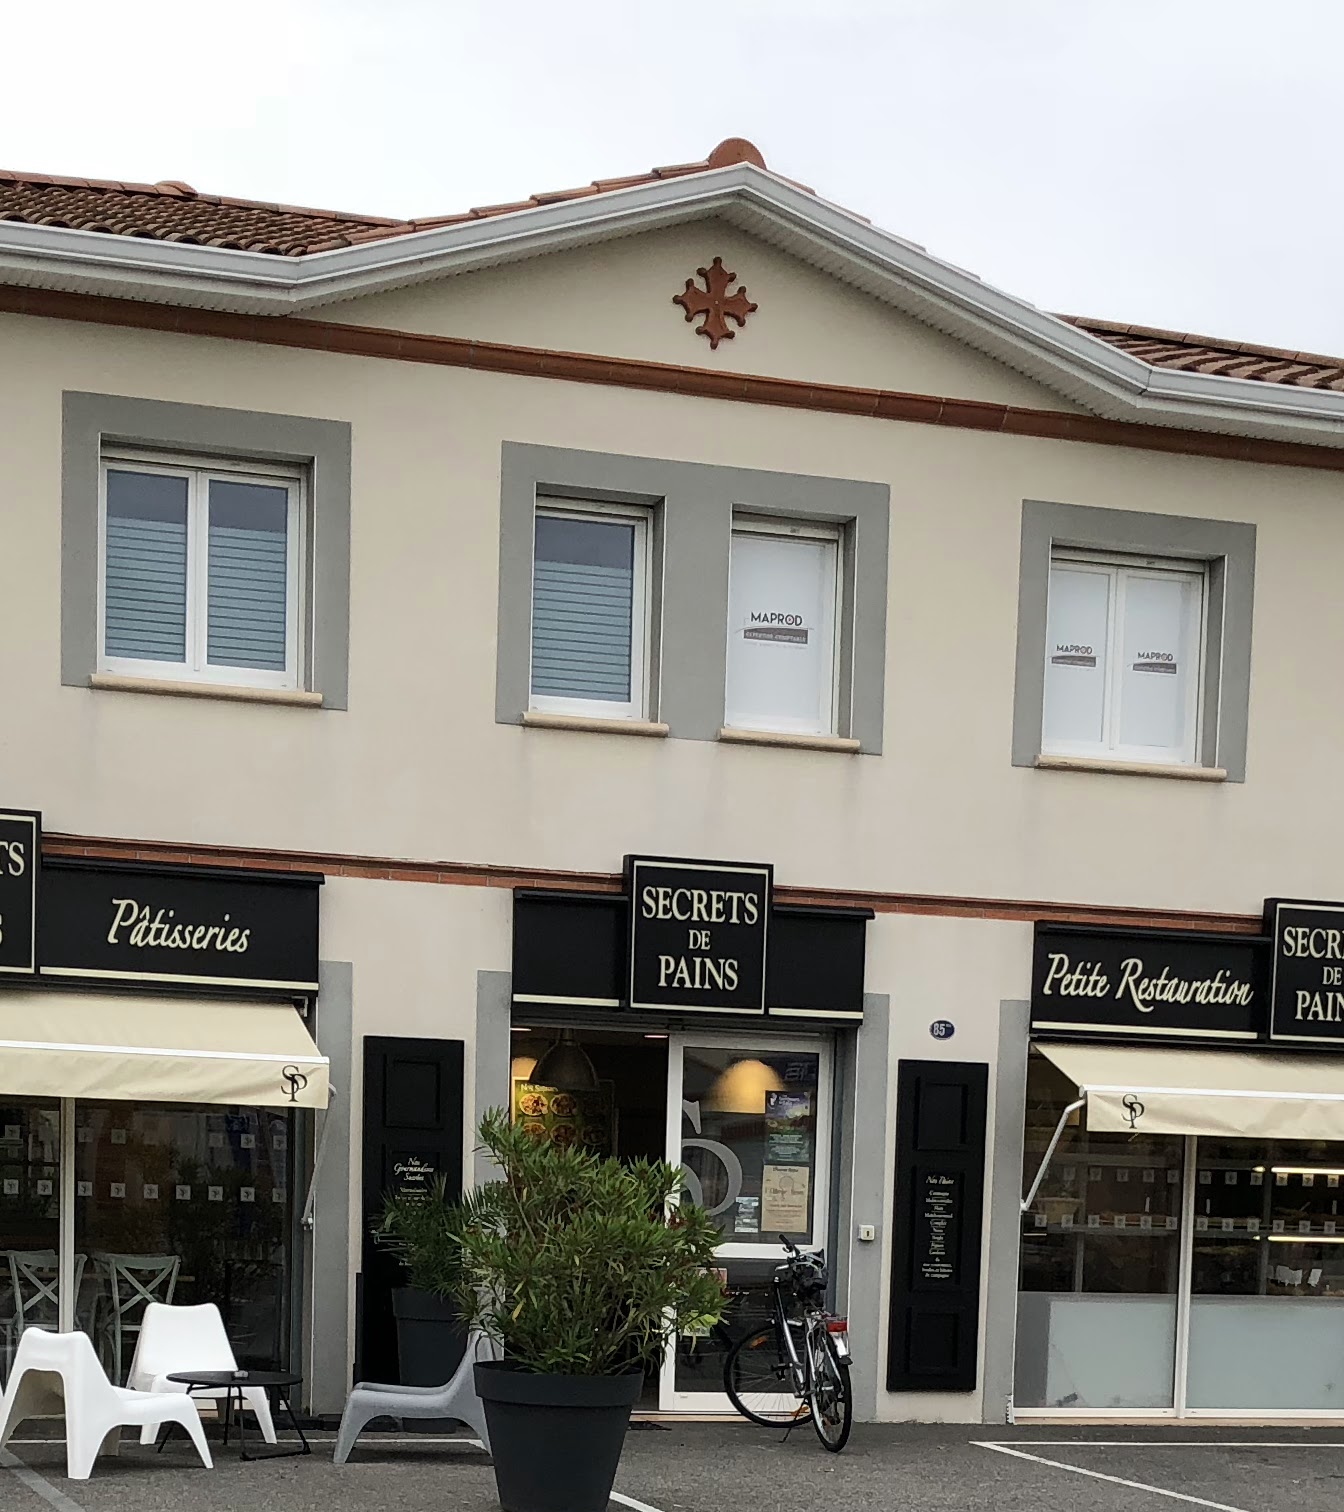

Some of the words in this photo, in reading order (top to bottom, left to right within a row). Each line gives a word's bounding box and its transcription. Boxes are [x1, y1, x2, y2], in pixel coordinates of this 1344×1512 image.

[750, 611, 803, 627] MAPROD
[1056, 643, 1093, 655] MAPROD
[1137, 651, 1174, 662] MAPROD
[642, 885, 758, 926] SECRETS
[106, 898, 251, 953] Pâtisseries
[688, 929, 711, 951] DE
[658, 955, 739, 992] PAINS
[1043, 953, 1110, 999] Petite
[1117, 957, 1254, 1012] Restauration
[1322, 966, 1343, 987] DE
[933, 1022, 946, 1037] 85
